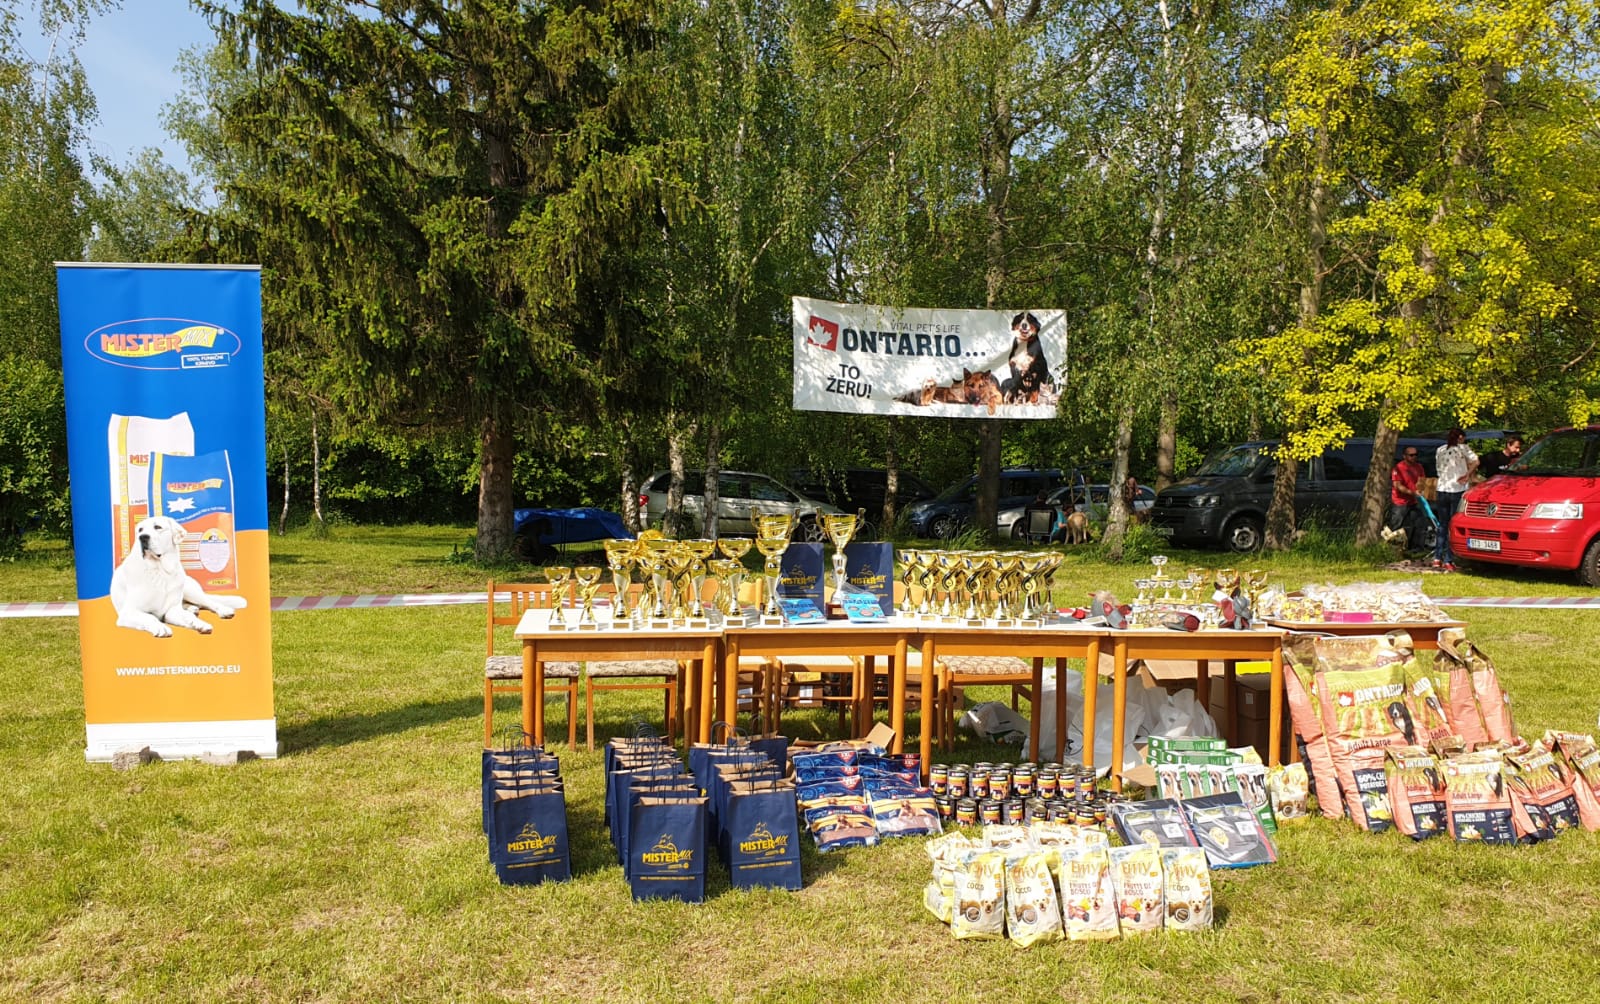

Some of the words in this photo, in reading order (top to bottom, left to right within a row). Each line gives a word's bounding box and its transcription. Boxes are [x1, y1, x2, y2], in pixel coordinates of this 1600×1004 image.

[891, 322, 914, 332] VITAL
[917, 323, 941, 333] PET'S
[943, 324, 961, 334] LIFE
[101, 333, 182, 353] MISTER
[839, 364, 860, 380] TO
[826, 376, 872, 400] ŽERU!
[781, 577, 807, 586] MISTER
[850, 577, 877, 585] MISTER
[116, 665, 241, 676] WWW.MISTERMIXDOG.EU
[1347, 740, 1369, 752] Adult
[1370, 738, 1392, 750] Large
[507, 839, 544, 853] MISTER
[740, 839, 775, 853] MISTER
[642, 852, 679, 863] MISTER
